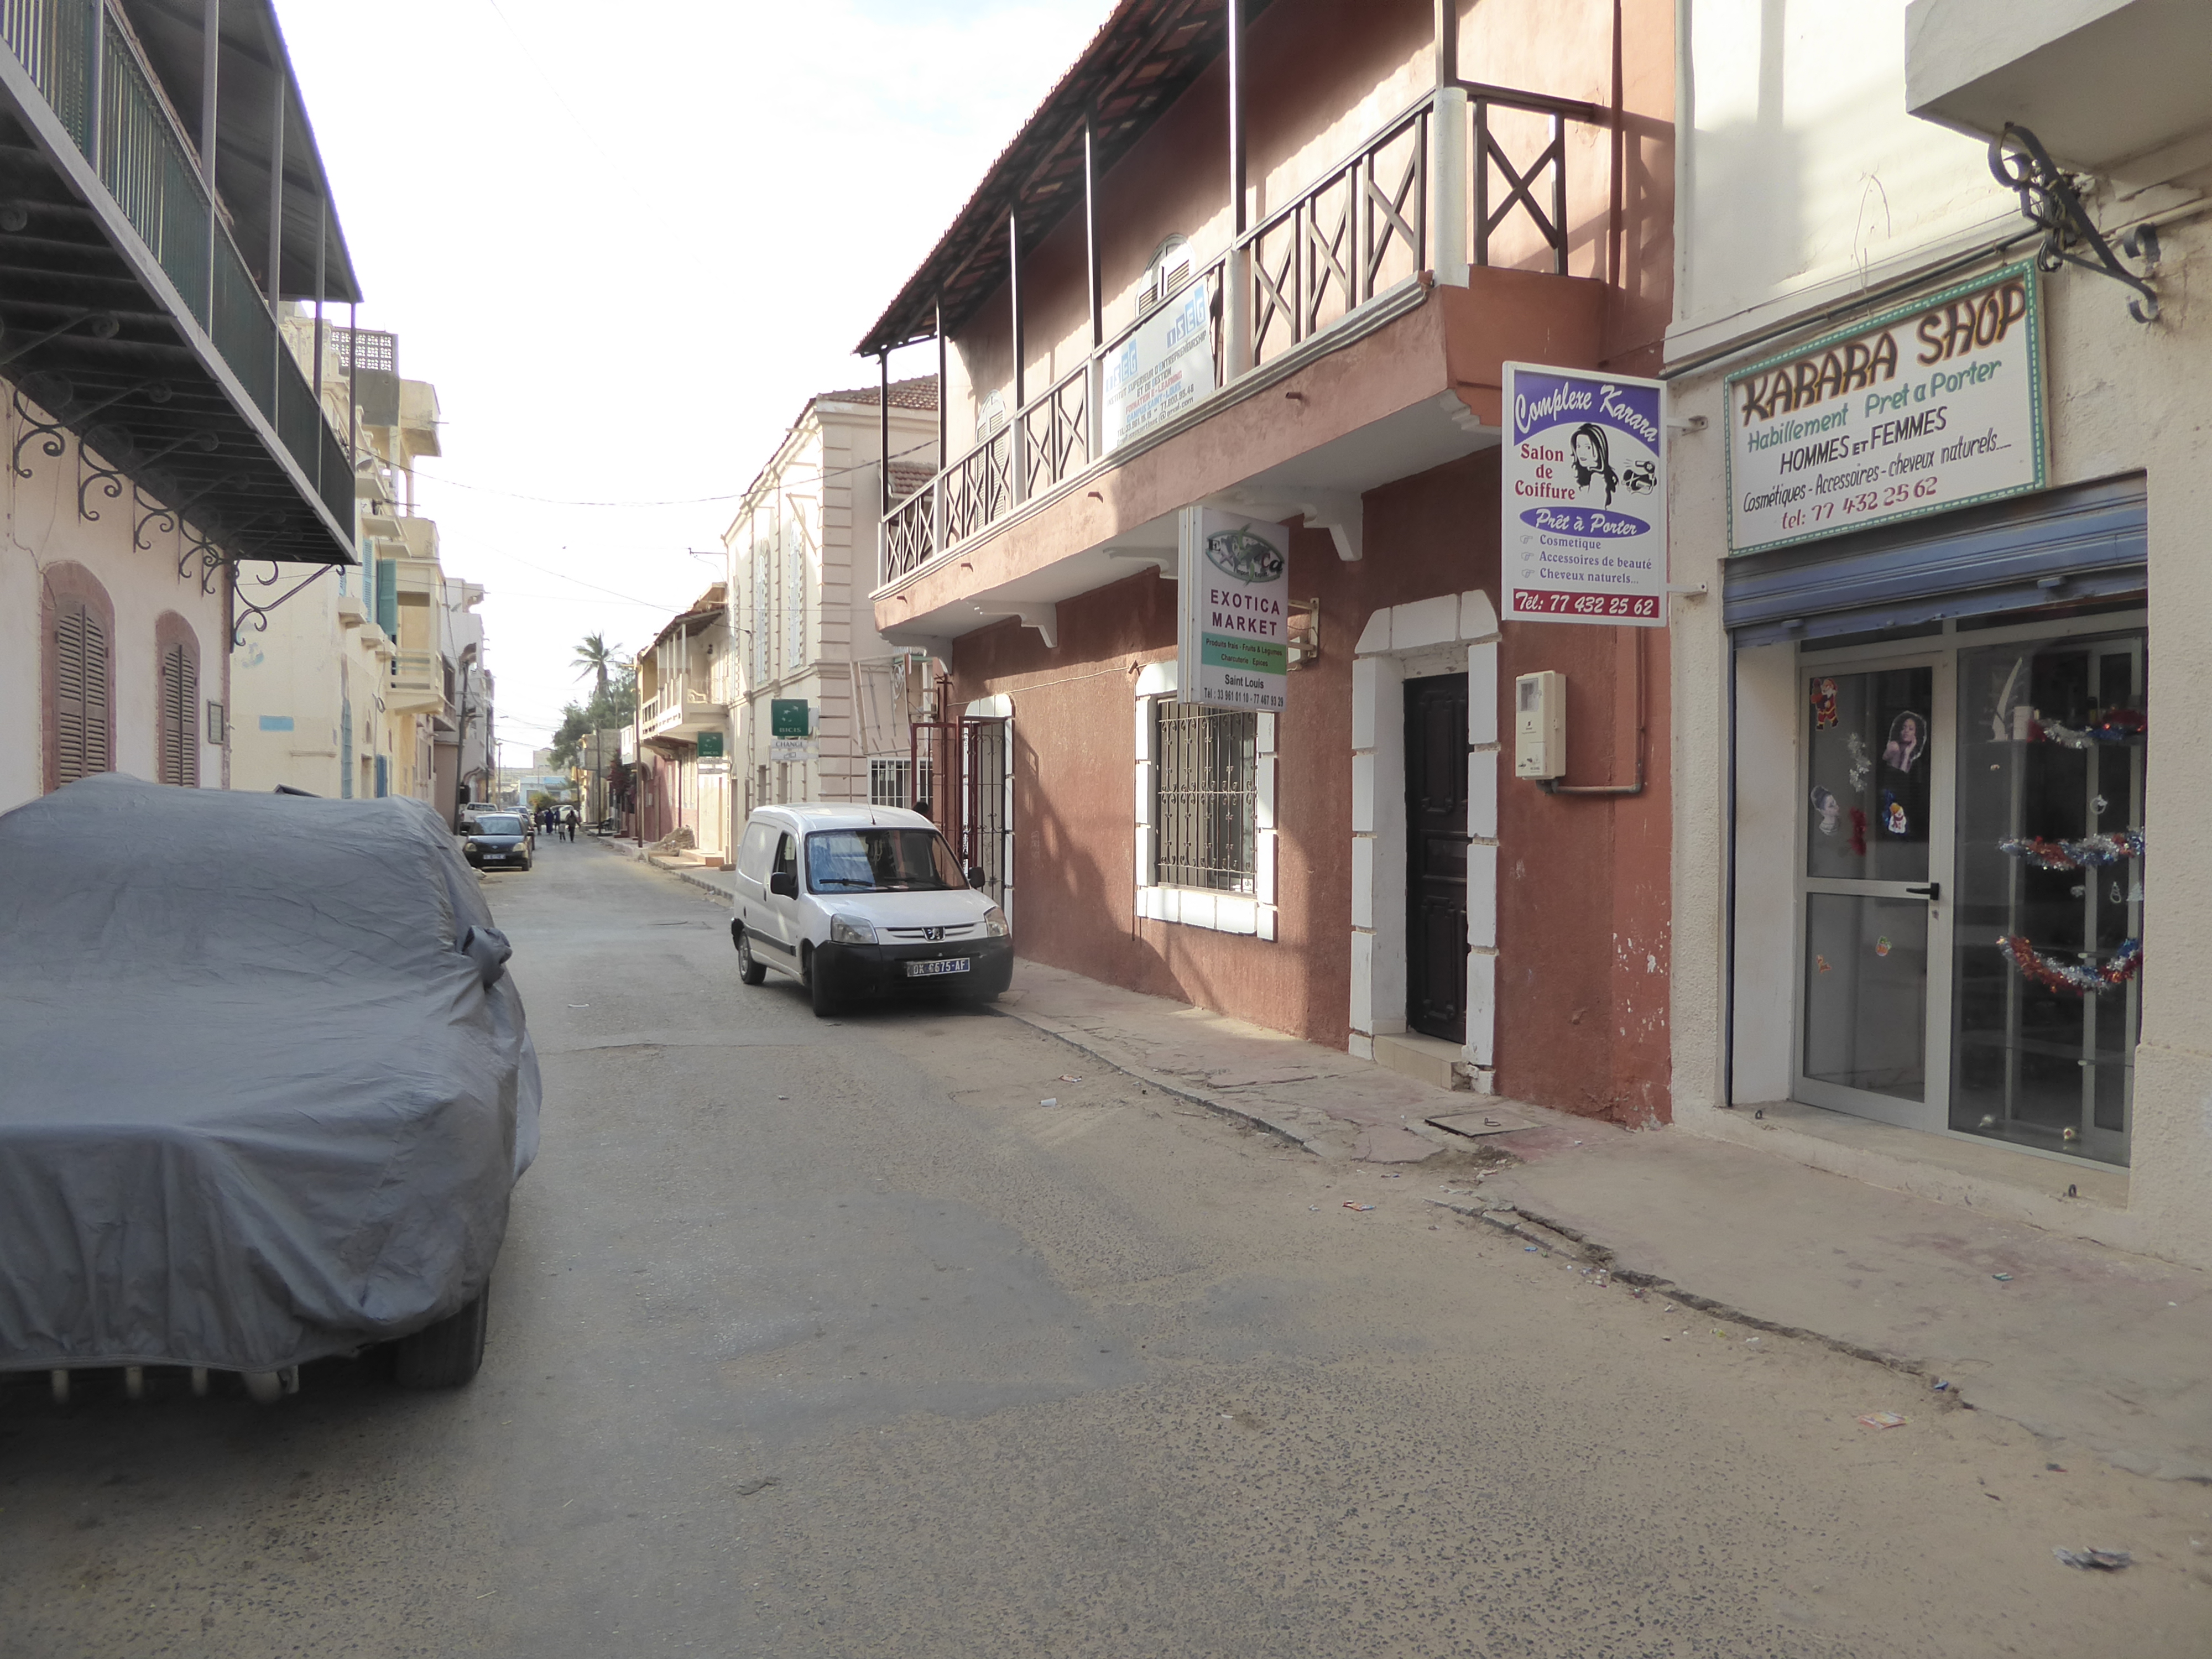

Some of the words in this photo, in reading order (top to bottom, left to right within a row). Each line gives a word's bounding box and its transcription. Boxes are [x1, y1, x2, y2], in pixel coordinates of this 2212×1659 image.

[1741, 330, 1898, 426] KARARA
[1916, 282, 2027, 367] SHOP
[1126, 404, 1147, 423] CAMPUS
[1515, 382, 1593, 434] Complexe
[1600, 384, 1658, 443] Karara
[1747, 402, 1849, 453] Habillement
[1865, 383, 1910, 418] Pret
[1914, 385, 1927, 403] a
[1930, 359, 2002, 398] Porter
[1780, 435, 1850, 474] HOMMES
[1851, 440, 1868, 456] ET
[1869, 406, 1948, 450] FEMMES
[1520, 443, 1564, 461] Salon
[1536, 463, 1553, 479] de
[1815, 463, 1879, 497] Accessoires
[1888, 450, 1934, 478] cheveux
[1515, 479, 1575, 500] Coiffure
[1811, 502, 1834, 522] 77
[1842, 489, 1879, 514] 432
[1882, 483, 1910, 505] 25
[1913, 476, 1938, 498] 62
[1535, 508, 1569, 530] Prêt
[1574, 517, 1584, 531] à
[1590, 513, 1637, 535] Porter
[1540, 534, 1601, 550] Cosmetique
[1539, 551, 1599, 566] Accessoires
[1603, 556, 1614, 567] de
[1617, 557, 1652, 570] beauté
[1540, 567, 1584, 582] Cheveux
[1210, 588, 1280, 615] EXOTICA
[1550, 594, 1570, 612] 77
[1574, 596, 1603, 613] 432
[1609, 598, 1628, 614] 25
[1634, 598, 1653, 615] 62
[1212, 612, 1277, 636] MARKET
[1206, 638, 1227, 648] Produits
[1228, 641, 1238, 650] frais
[1242, 644, 1256, 652] Fruits
[1221, 654, 1249, 664] Charcuterie
[1253, 658, 1268, 667] Epices
[1225, 674, 1243, 686] Saint
[1245, 677, 1264, 688] Louis
[1218, 689, 1223, 700] 33
[1225, 691, 1234, 701] 961
[1235, 691, 1241, 702] 01
[1243, 692, 1249, 703] 10
[1254, 693, 1259, 704] 77
[1261, 695, 1269, 705] 467
